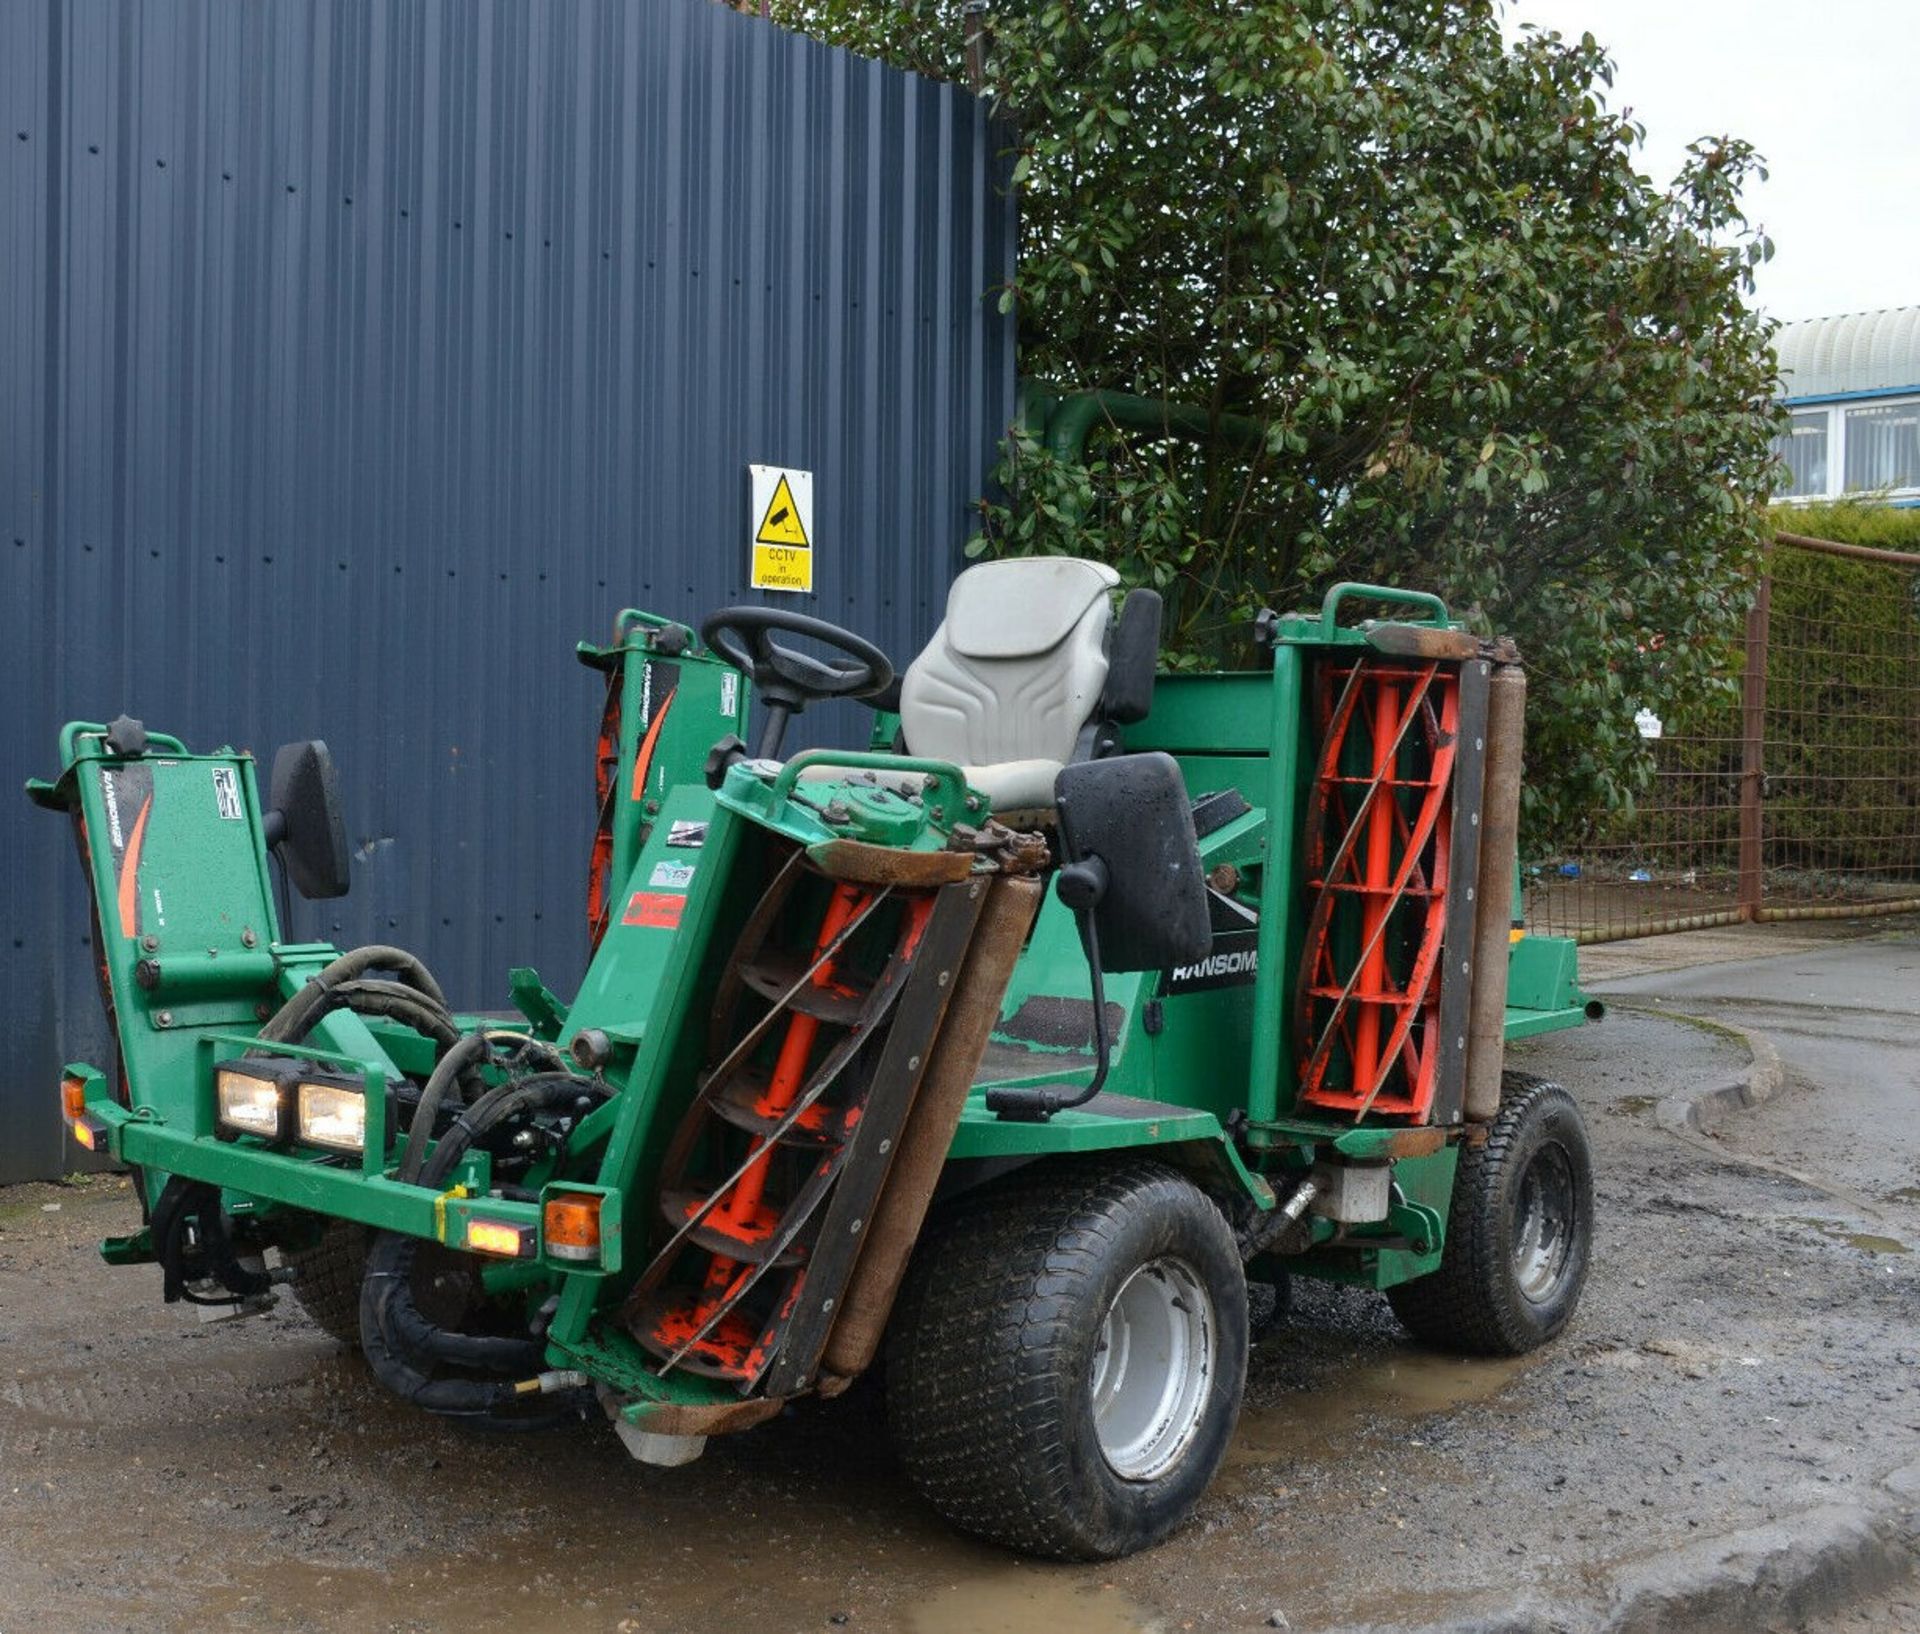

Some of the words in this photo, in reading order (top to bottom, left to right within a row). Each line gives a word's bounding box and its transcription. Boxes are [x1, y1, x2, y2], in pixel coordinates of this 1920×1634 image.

[768, 548, 796, 561] CCTV
[761, 575, 803, 587] operation
[103, 770, 123, 848] RANSOMES
[1172, 950, 1258, 981] RANSOM
